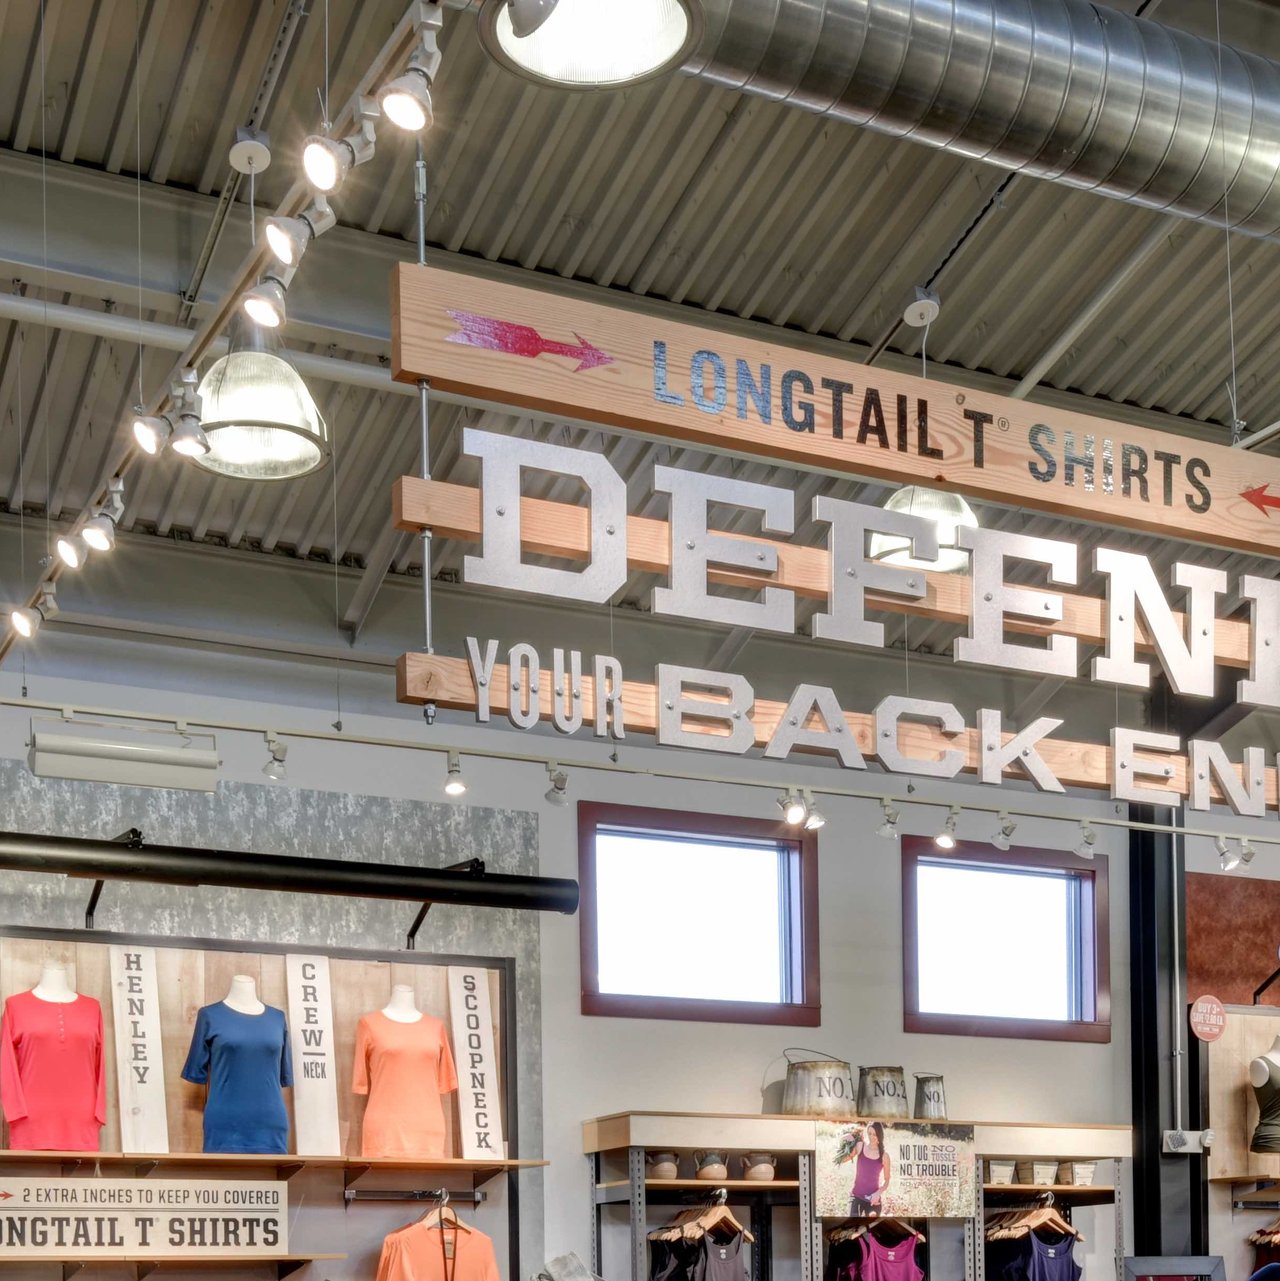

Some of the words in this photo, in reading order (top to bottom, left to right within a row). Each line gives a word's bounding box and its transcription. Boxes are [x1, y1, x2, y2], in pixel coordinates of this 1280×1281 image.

[652, 340, 943, 460] LONGTAIL
[1028, 422, 1212, 515] SHIRTS
[463, 636, 625, 740] YOUR
[656, 663, 1065, 793] BACK
[301, 963, 324, 1047] CREW
[124, 953, 150, 1084] HENLEY
[303, 1061, 327, 1080] NECK
[463, 974, 492, 1149] SCOOPNECK
[874, 1080, 908, 1099] NO.2
[900, 1144, 911, 1160] NO
[913, 1145, 928, 1161] TUG
[931, 1145, 956, 1153] NO
[931, 1153, 956, 1162] TUSSLE
[900, 1164, 912, 1176] NO
[916, 1164, 957, 1177] TROUBLE
[23, 1188, 31, 1203] 2
[36, 1188, 78, 1203] EXTRA
[83, 1189, 133, 1204] INCHES
[137, 1189, 153, 1204] TO
[158, 1190, 190, 1204] KEEP
[195, 1190, 219, 1204] YOU
[224, 1190, 279, 1204] COVERED
[169, 1217, 279, 1247] SHIRTS
